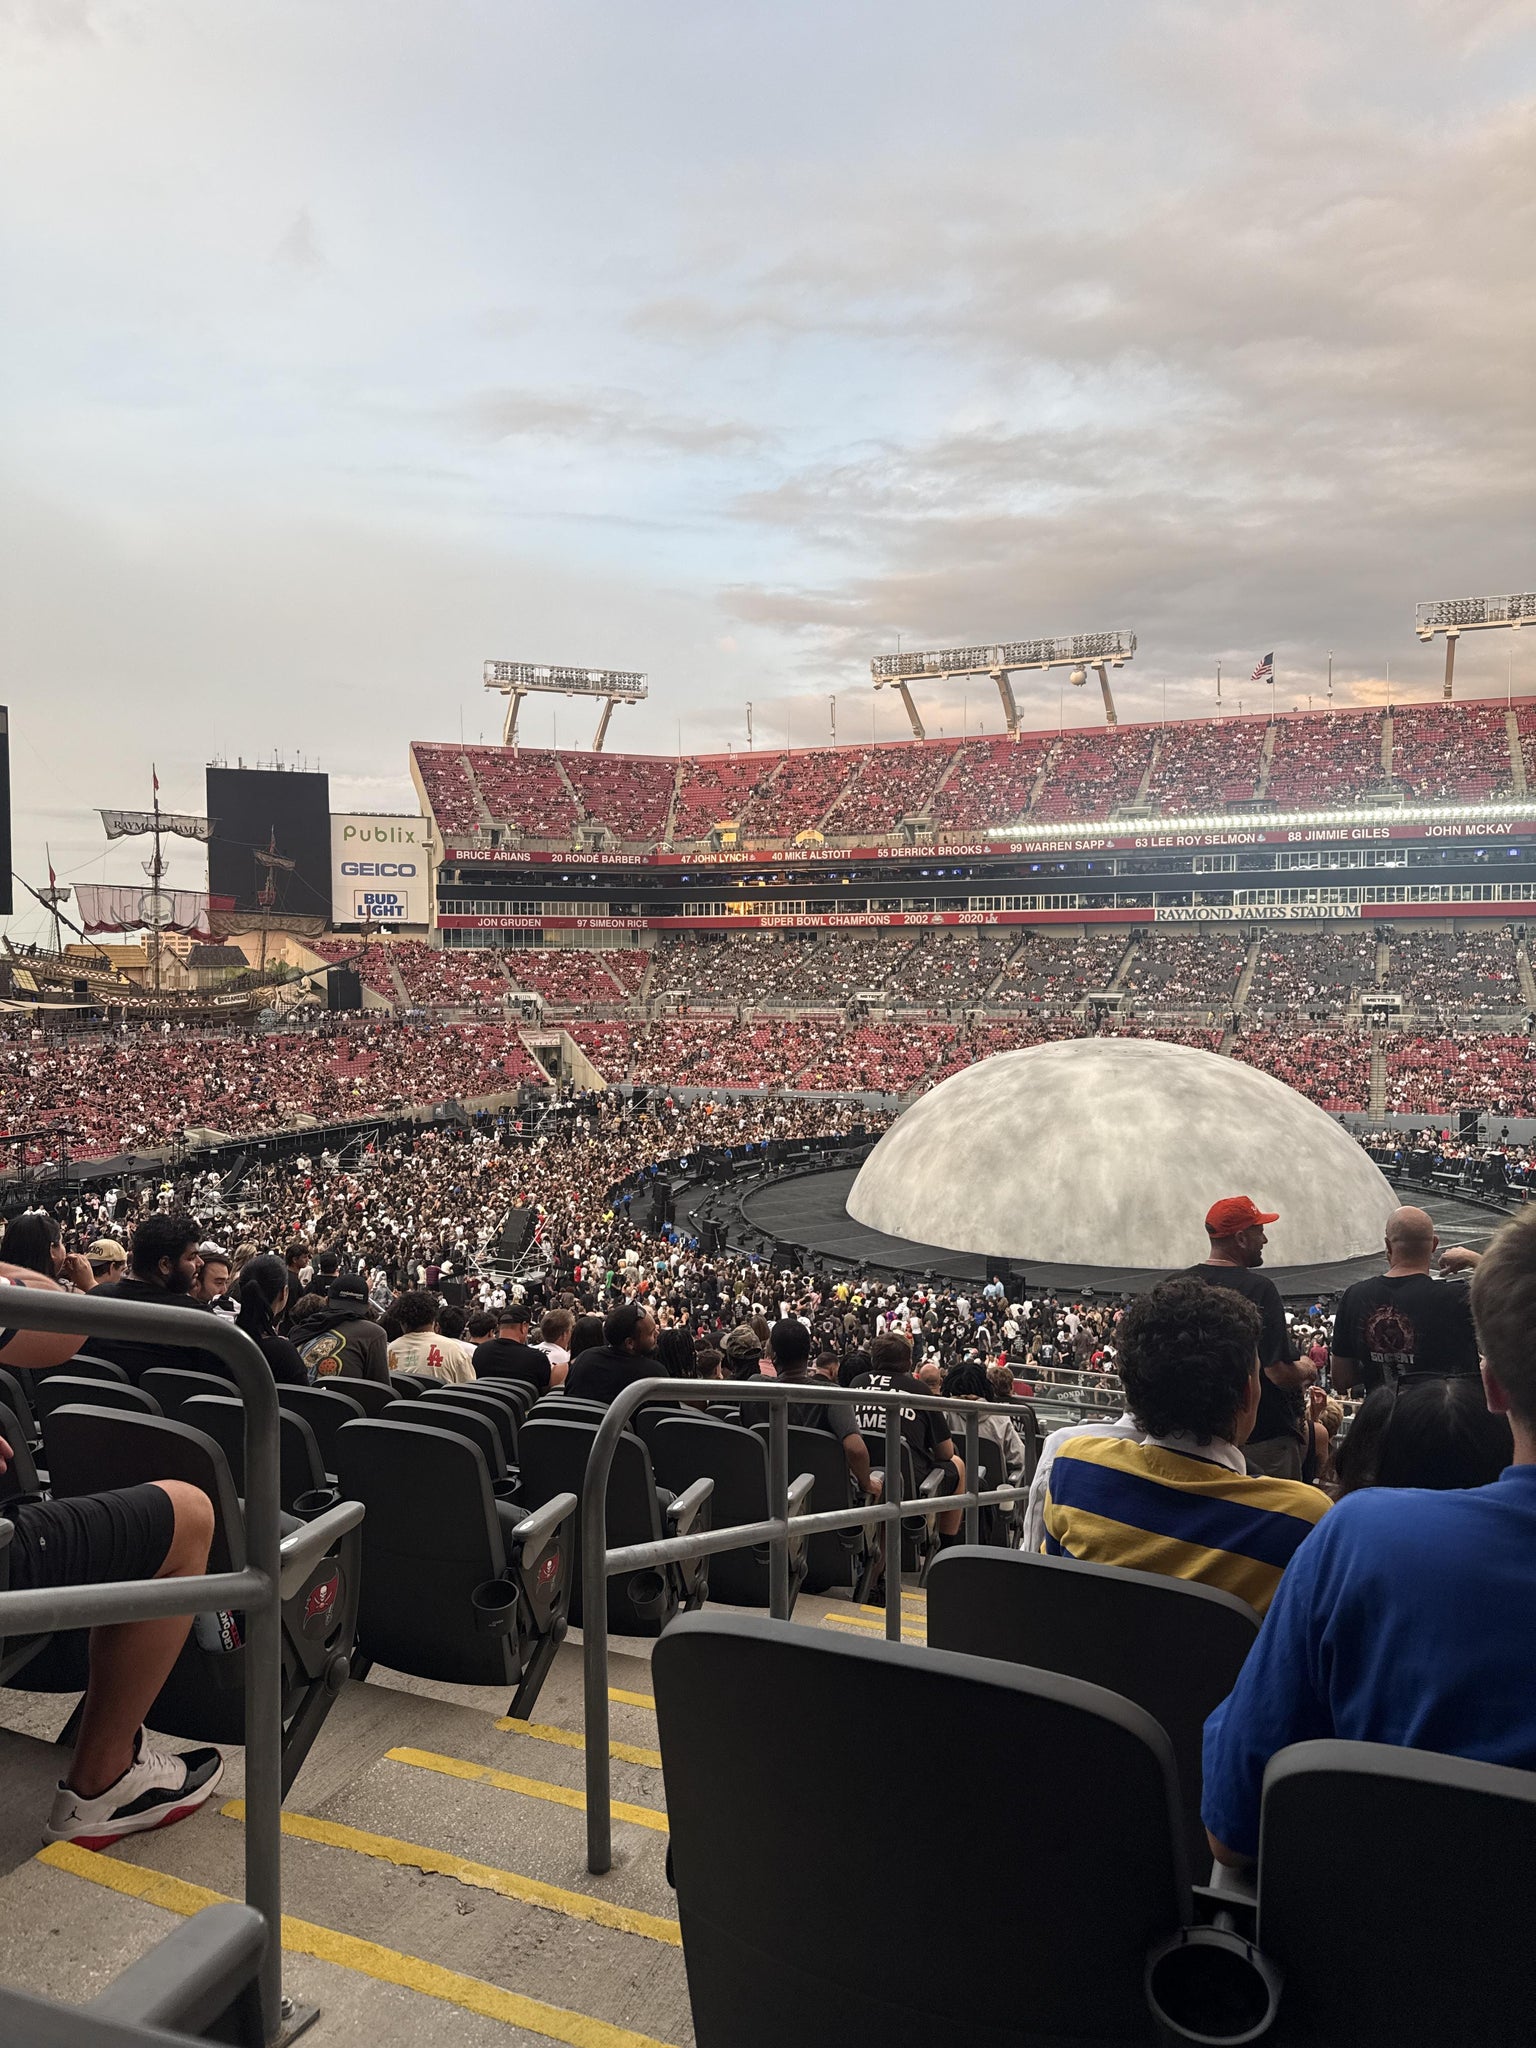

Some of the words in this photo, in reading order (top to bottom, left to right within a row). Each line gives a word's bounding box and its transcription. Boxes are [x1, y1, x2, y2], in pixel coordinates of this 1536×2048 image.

[343, 825, 415, 843] Publix
[1288, 832, 1301, 842] 88
[1305, 830, 1348, 841] JIMMIE
[1350, 828, 1390, 839] GILES
[1425, 826, 1462, 837] JOHN
[1465, 823, 1513, 835] MCKAY
[1010, 843, 1023, 853] 99
[1024, 841, 1073, 852] WARREN
[1075, 840, 1105, 850] SAPP
[1135, 838, 1148, 848] 63
[1151, 836, 1173, 847] LEE
[1176, 835, 1202, 846] ROY
[1204, 833, 1256, 845] SELMON
[456, 850, 491, 860] BRUCE
[493, 852, 531, 862] ARIANS
[772, 852, 783, 861] 40
[784, 851, 808, 861] MIKE
[809, 850, 852, 860] ALSTOTT
[878, 848, 889, 858] 55
[891, 846, 937, 857] DERRICK
[938, 845, 982, 856] BROOKS
[551, 854, 563, 862] 20
[565, 852, 599, 863] RONDÉ
[601, 854, 641, 864] BARBER
[681, 855, 692, 864] 47
[693, 854, 717, 864] JOHN
[718, 853, 749, 863] LYNCH
[341, 862, 416, 877] GEICO
[364, 893, 398, 905] BUD
[958, 913, 984, 923] 2020
[1156, 908, 1233, 920] RAYMOND
[1234, 907, 1286, 920] JAMES
[1290, 905, 1360, 918] STADIUM
[477, 918, 499, 927] JON
[500, 918, 542, 927] GRUDEN
[576, 919, 588, 928] 97
[589, 919, 625, 928] SIMEON
[627, 919, 648, 928] RICE
[760, 917, 794, 927] SUPER
[796, 916, 827, 926] BOWL
[828, 915, 891, 926] CHAMPIONS
[904, 914, 929, 924] 2002
[426, 1344, 444, 1368] LA
[868, 1373, 892, 1387] YE
[1056, 1389, 1085, 1400] DONDA
